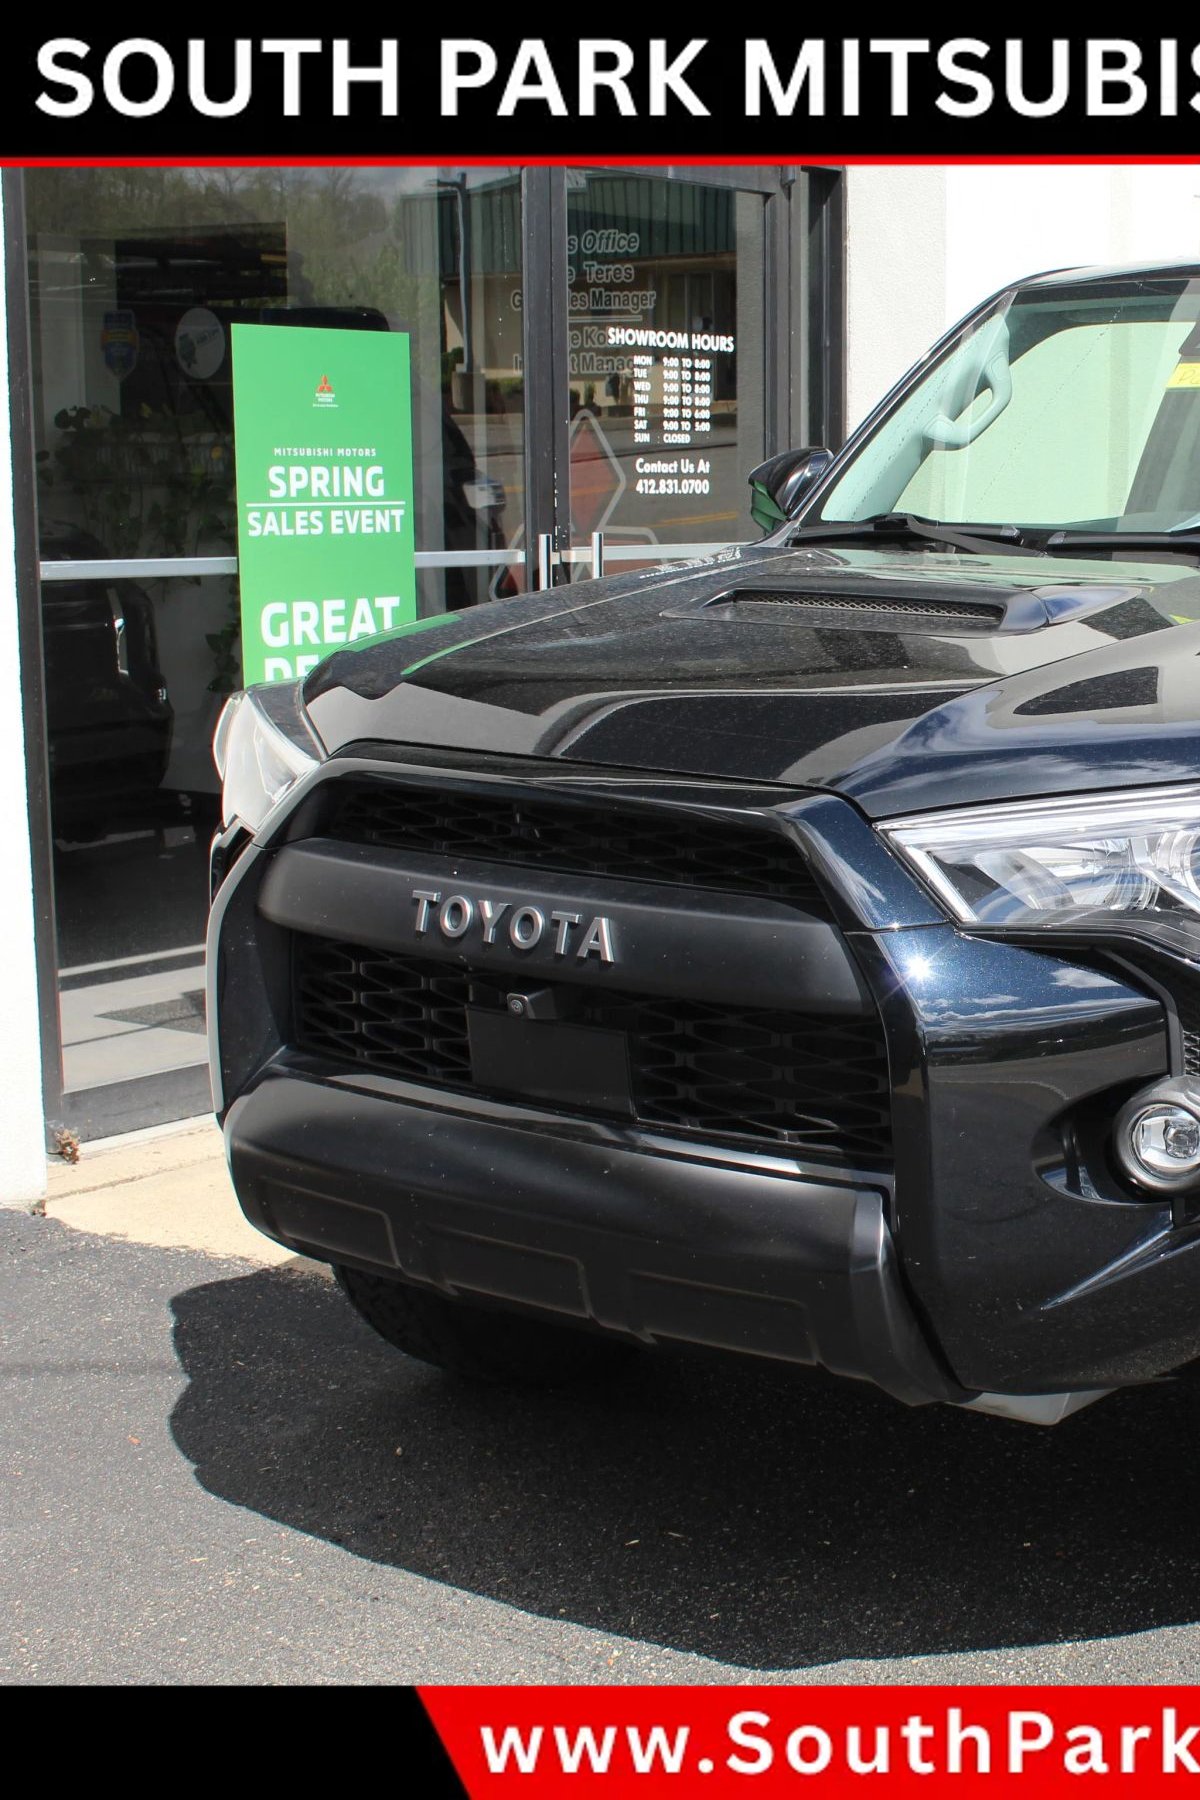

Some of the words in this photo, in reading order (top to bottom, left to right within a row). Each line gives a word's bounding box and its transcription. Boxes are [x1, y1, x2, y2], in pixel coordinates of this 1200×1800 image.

[582, 229, 640, 253] Office
[590, 288, 656, 313] Manager
[608, 326, 689, 350] SHOWROOM
[691, 333, 735, 353] HOURS
[633, 354, 653, 366] MON
[663, 356, 679, 368] 9:00
[681, 358, 692, 369] TO
[633, 368, 648, 379] TUE
[663, 369, 679, 381] 9:00
[681, 371, 692, 382] TO
[633, 381, 651, 392] WED
[663, 382, 679, 393] 9:00
[681, 383, 692, 394] TO
[633, 394, 649, 405] THU
[663, 395, 679, 406] 9:00
[681, 396, 692, 407] TO
[633, 407, 646, 418] FRI
[663, 408, 679, 419] 9:00
[681, 409, 692, 420] TO
[633, 420, 648, 431] SAT
[663, 420, 679, 432] 9:00
[680, 422, 692, 432] TO
[633, 433, 651, 444] SUN
[663, 434, 691, 444] CLOSED
[274, 447, 334, 457] MITSUBISHI
[337, 447, 377, 457] MOTORS
[635, 458, 678, 474] Contact
[680, 459, 695, 474] Us
[697, 459, 711, 474] At
[268, 465, 385, 499] SPRING
[635, 479, 711, 495] 412.831.0700
[247, 509, 325, 537] SALES
[330, 508, 405, 535] EVENT
[260, 596, 401, 648] GREAT
[412, 889, 615, 963] TOYOTA
